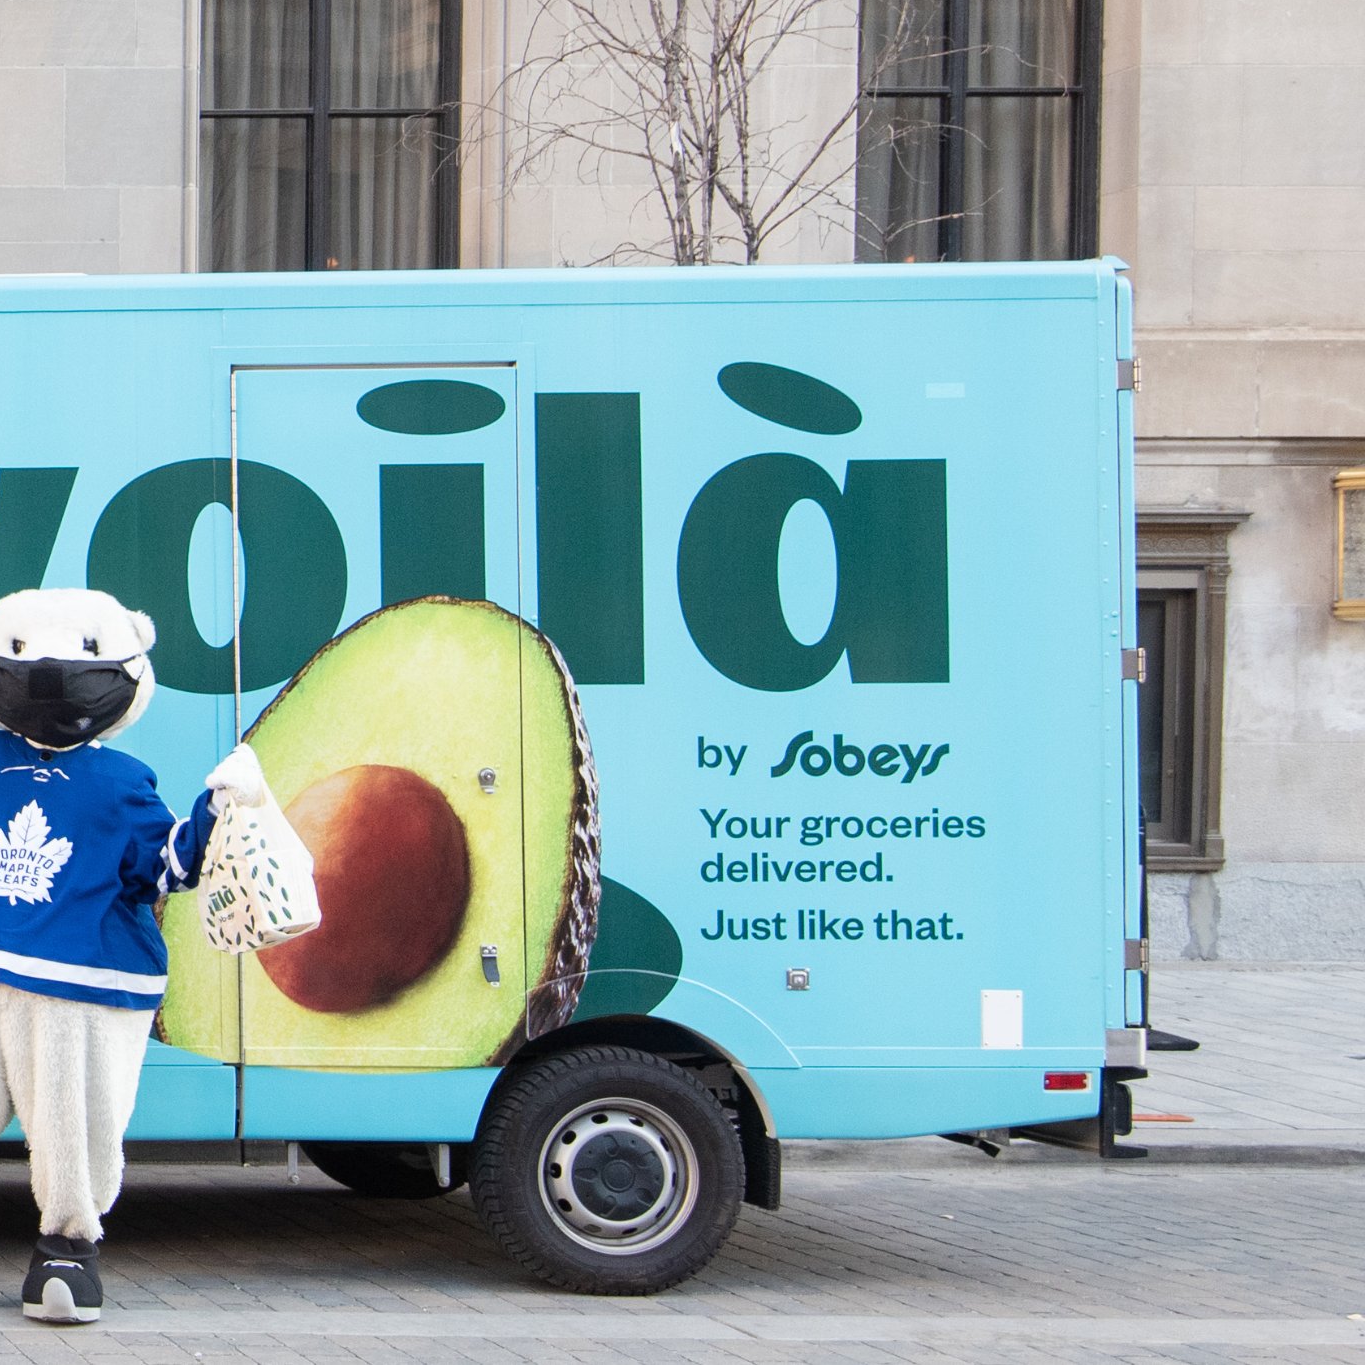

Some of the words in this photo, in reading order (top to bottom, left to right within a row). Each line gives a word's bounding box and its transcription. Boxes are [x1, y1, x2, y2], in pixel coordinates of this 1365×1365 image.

[697, 735, 748, 777] by
[770, 730, 950, 784] Sobeys
[699, 807, 791, 839] Your
[799, 807, 987, 847] groceries
[0, 860, 42, 876] MAPLE
[699, 851, 894, 883] delivered.
[700, 909, 787, 941] Just
[797, 909, 865, 941] like
[873, 909, 965, 941] that.
